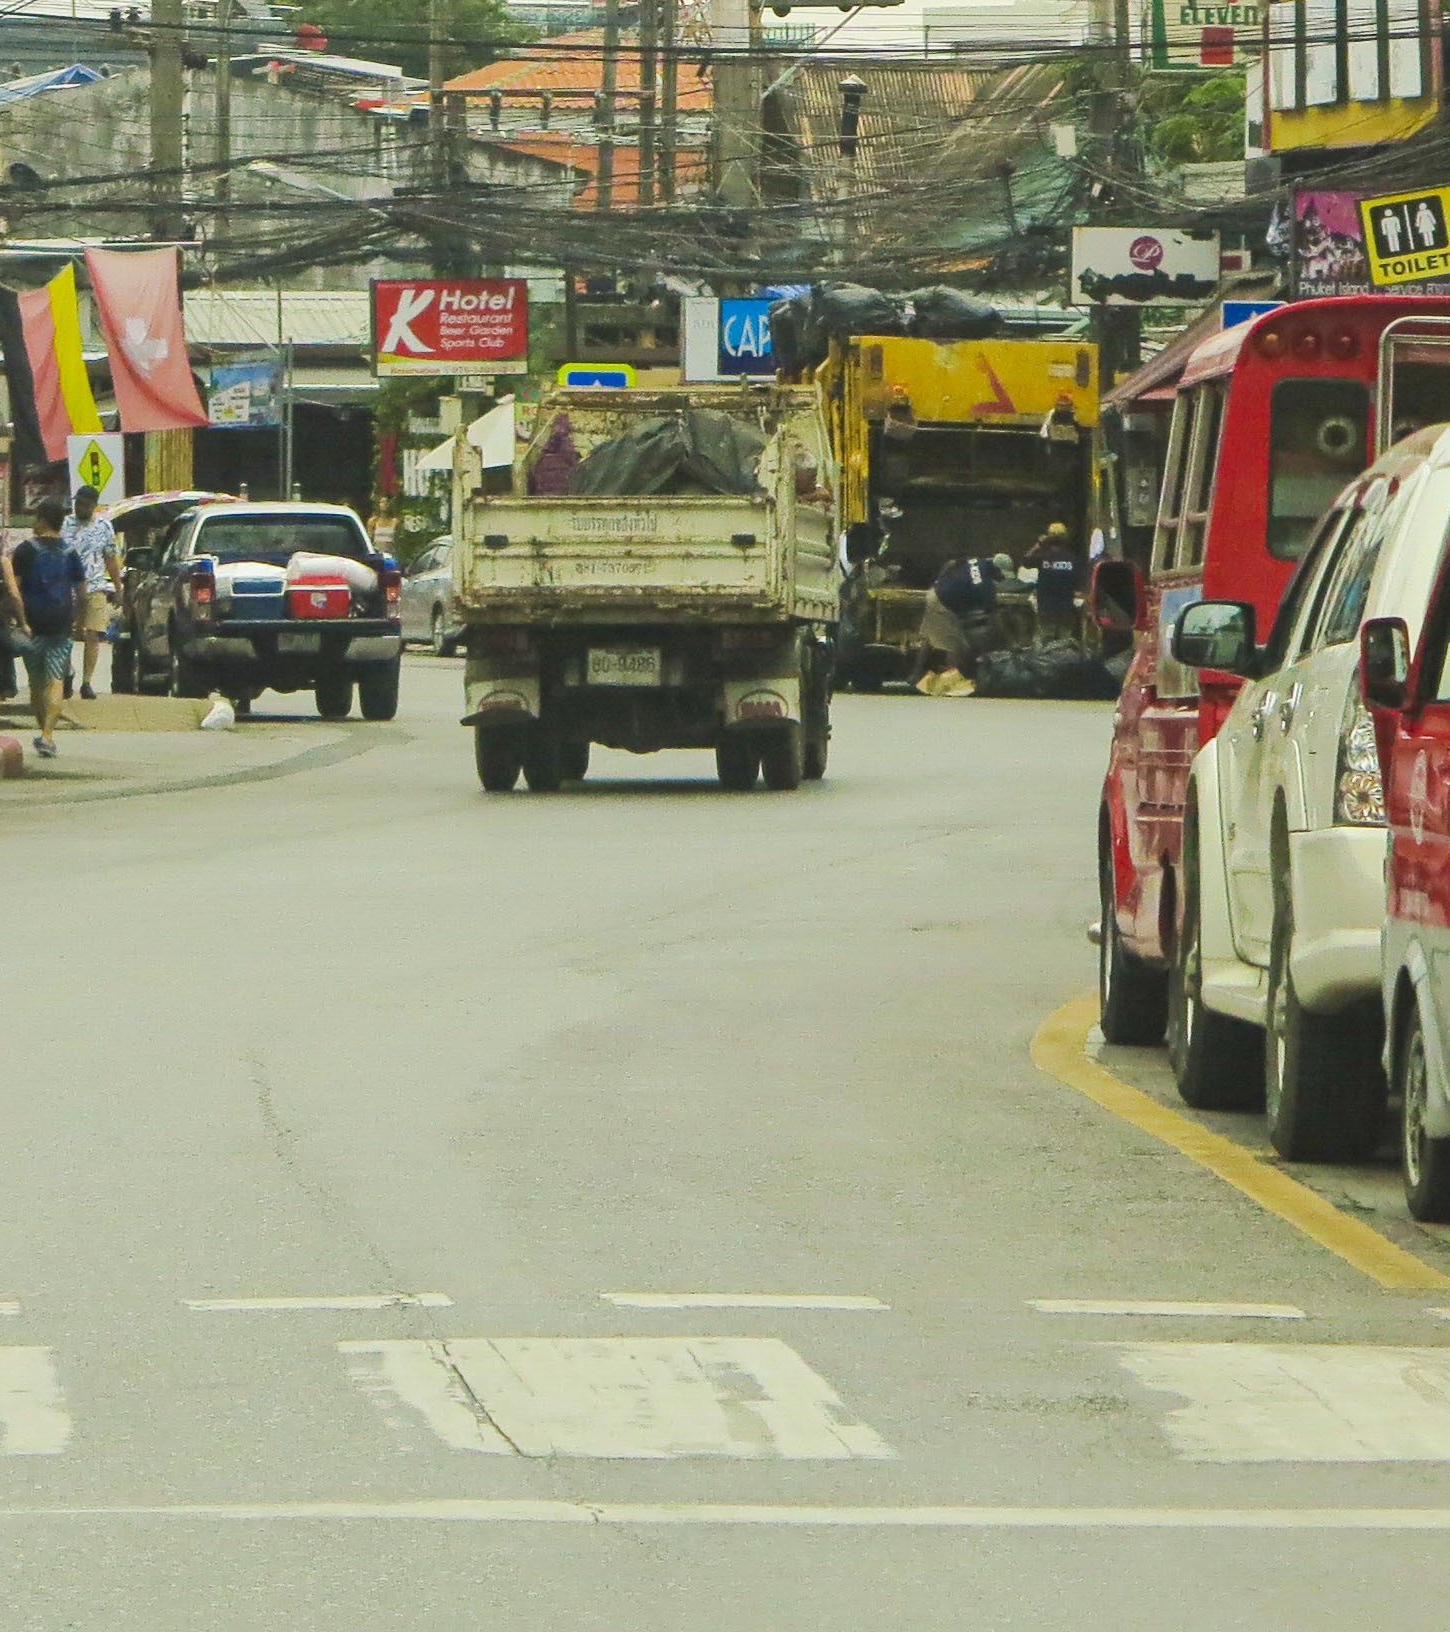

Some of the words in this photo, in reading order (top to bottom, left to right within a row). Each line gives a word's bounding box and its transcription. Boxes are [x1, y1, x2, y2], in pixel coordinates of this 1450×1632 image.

[1299, 280, 1336, 296] Phuket
[380, 288, 437, 353] K
[438, 286, 516, 311] Hotel
[439, 312, 513, 325] Restaurant
[439, 325, 467, 336] Beer
[468, 325, 514, 336] Garden
[439, 337, 476, 351] Sports
[478, 336, 506, 348] Club
